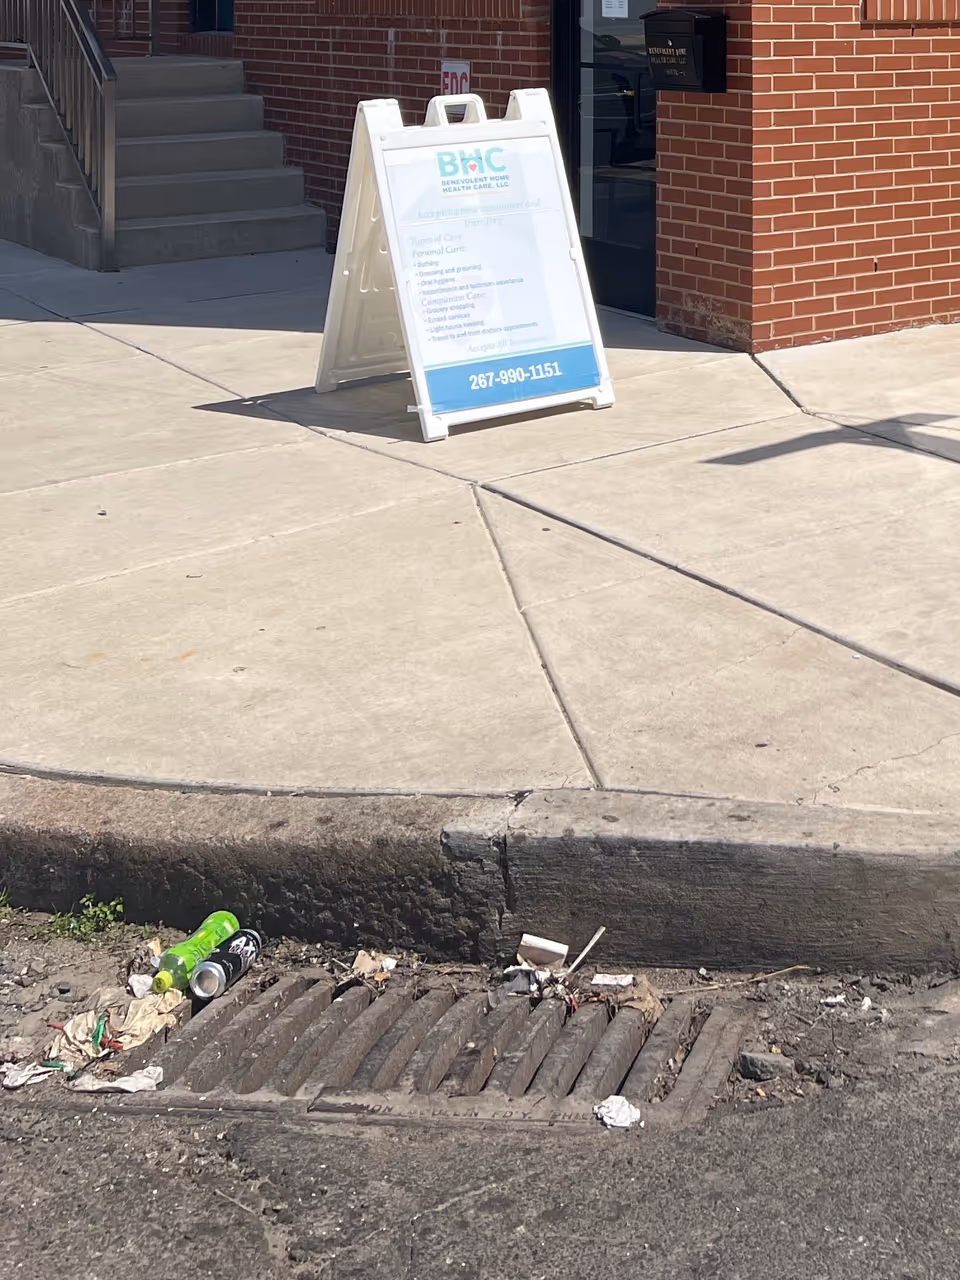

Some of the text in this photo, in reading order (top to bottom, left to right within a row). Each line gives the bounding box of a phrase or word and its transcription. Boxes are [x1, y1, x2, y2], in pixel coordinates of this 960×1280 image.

[436, 146, 507, 177] BHC
[441, 177, 488, 186] BENEVOLENT
[442, 185, 471, 193] HEALTH
[469, 361, 562, 390] 267-990-1151
